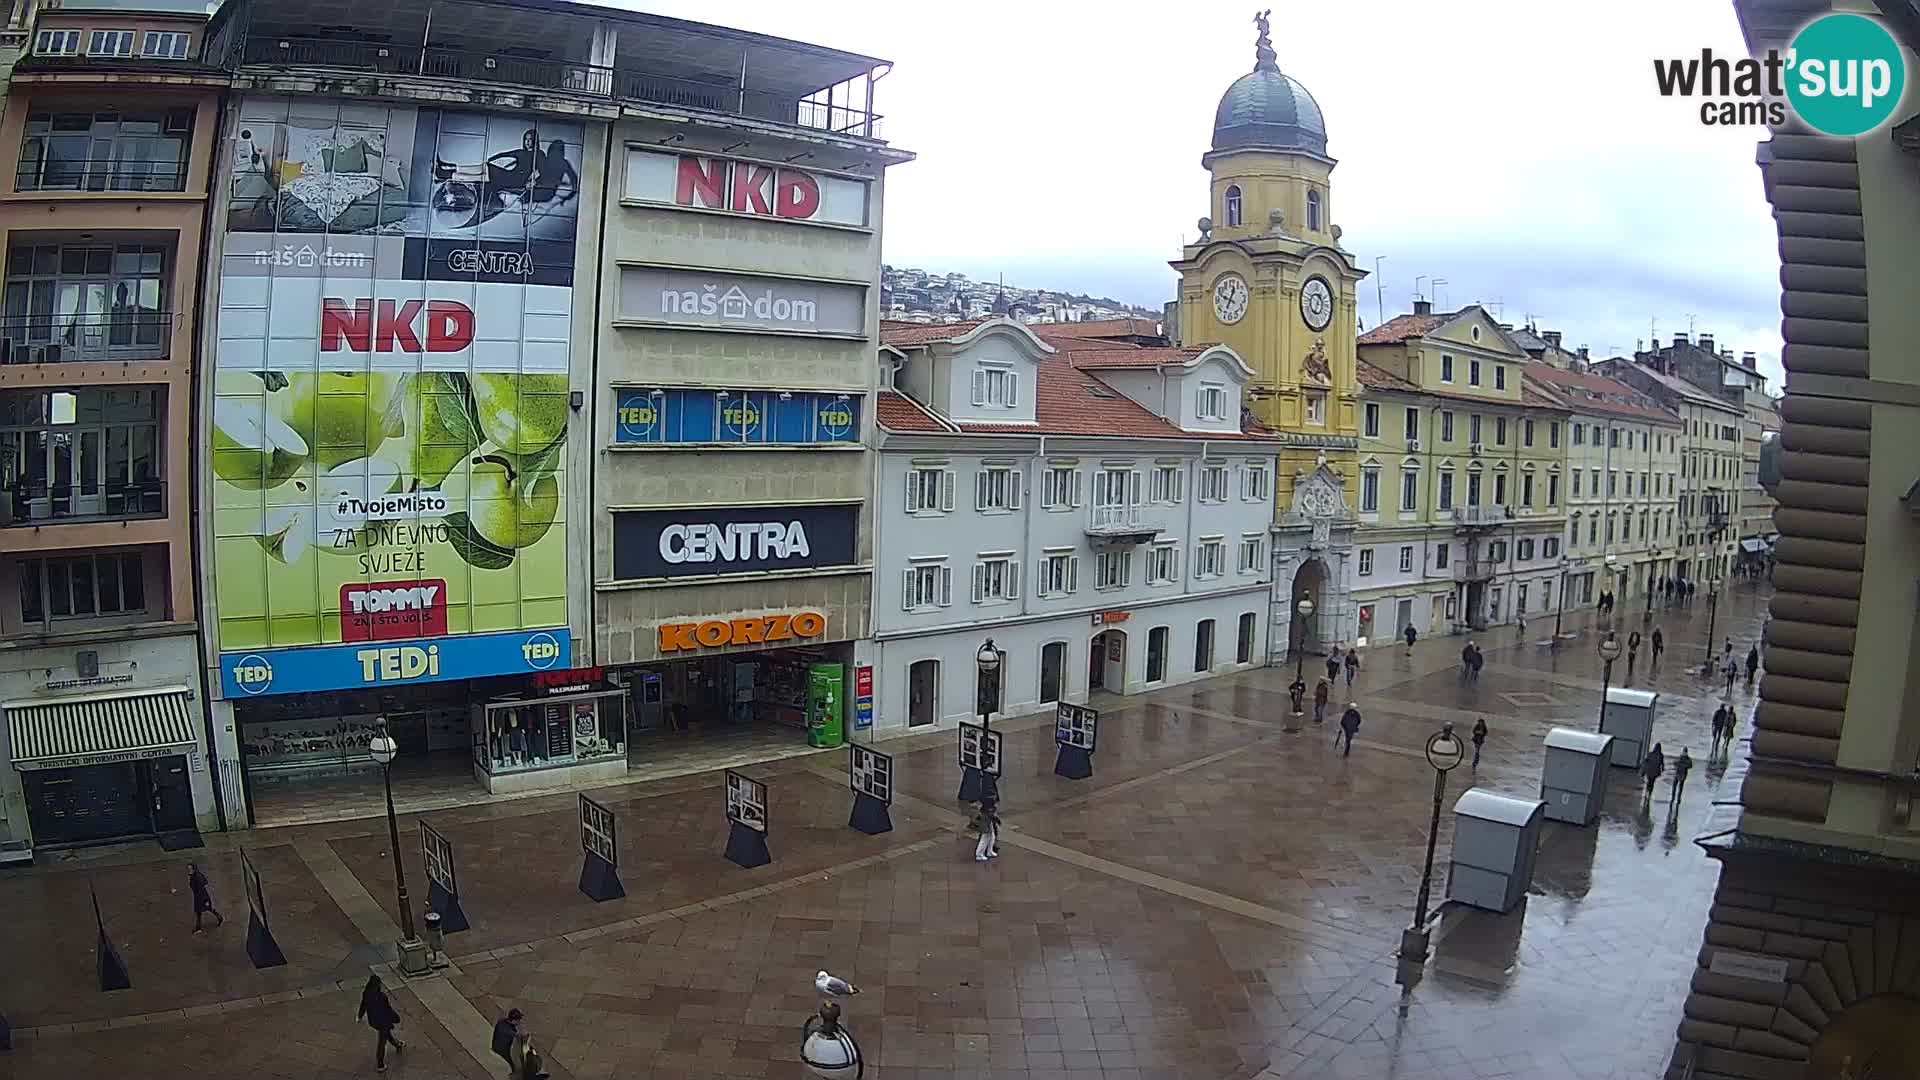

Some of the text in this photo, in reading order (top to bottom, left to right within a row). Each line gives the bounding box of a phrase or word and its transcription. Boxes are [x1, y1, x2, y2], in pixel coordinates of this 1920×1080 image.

[676, 157, 820, 219] NKD
[254, 244, 366, 268] naš dom
[447, 248, 535, 275] CENTRA
[661, 283, 816, 323] naš dom
[320, 297, 476, 352] NKD
[618, 407, 657, 424] TEDi
[723, 408, 760, 425] TEDi
[820, 410, 853, 426] TEDi
[337, 497, 446, 516] #TvojeMisto
[333, 523, 450, 548] ZA DNEVNO
[659, 520, 810, 564] CENTRA
[359, 546, 426, 575] SVJEŽE
[348, 586, 439, 614] TOMMY
[659, 611, 826, 652] KORZO
[357, 644, 439, 681] TEDi
[522, 642, 560, 660] TEDi
[233, 664, 273, 684] TEDi
[549, 684, 590, 694] MAXIMARKET
